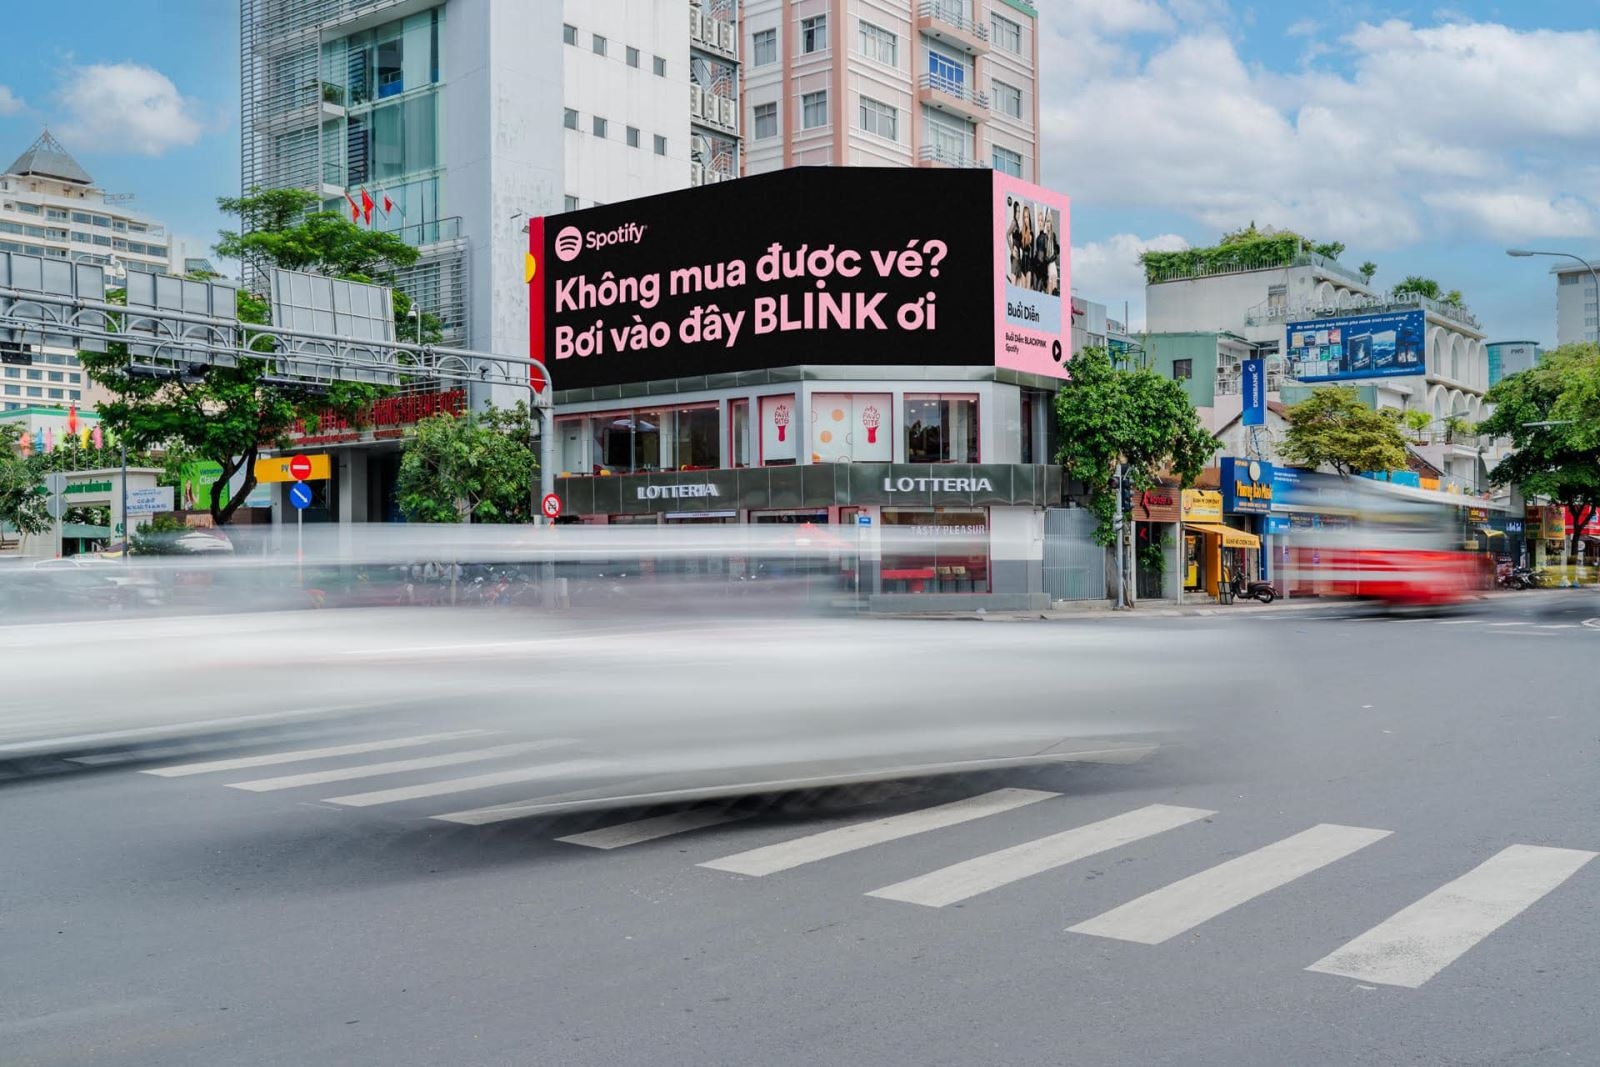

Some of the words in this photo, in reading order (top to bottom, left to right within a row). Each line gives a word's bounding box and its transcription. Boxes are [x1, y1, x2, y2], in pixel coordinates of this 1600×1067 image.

[586, 222, 645, 250] Spotify
[555, 271, 660, 313] Không
[670, 259, 746, 296] mua
[755, 242, 862, 289] được
[870, 239, 948, 278] vé?
[1007, 301, 1023, 319] Buổi
[555, 319, 604, 360] Bơi
[610, 314, 671, 352] vào
[679, 304, 746, 348] đây
[754, 291, 888, 335] BLINK
[896, 291, 936, 331] ơi
[637, 483, 719, 500] LOTTERIA
[883, 476, 993, 493] LOTTERIA
